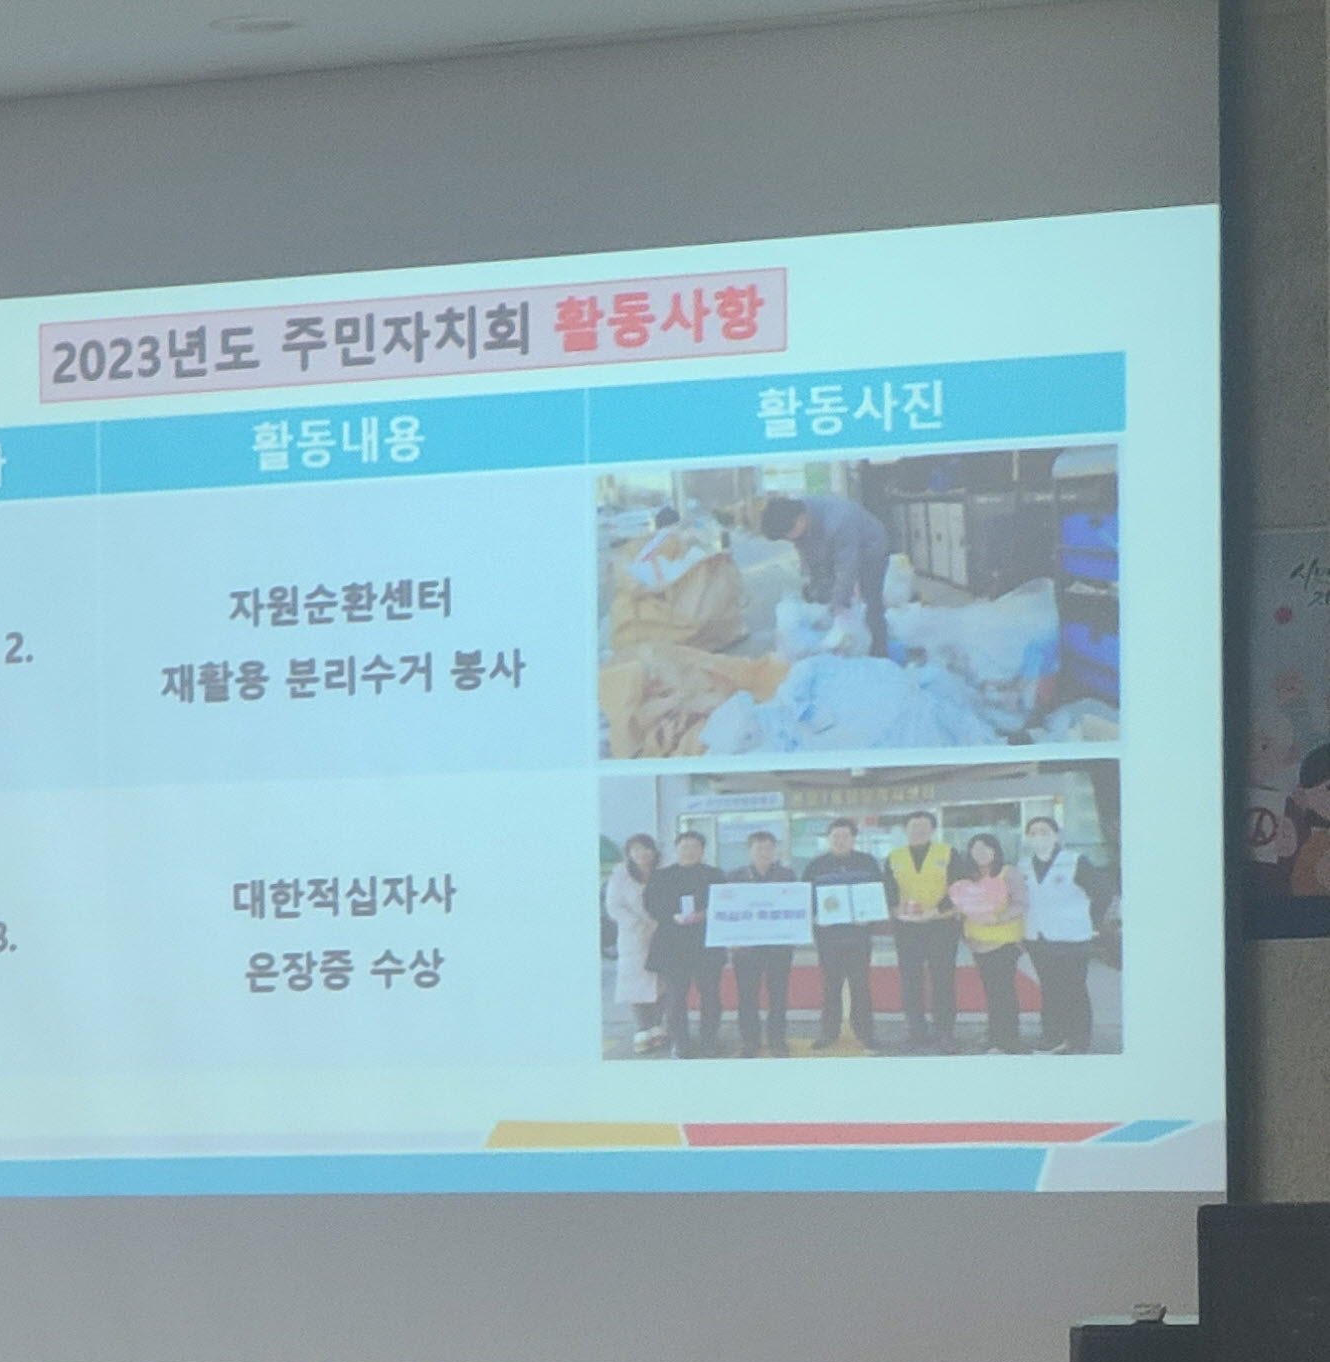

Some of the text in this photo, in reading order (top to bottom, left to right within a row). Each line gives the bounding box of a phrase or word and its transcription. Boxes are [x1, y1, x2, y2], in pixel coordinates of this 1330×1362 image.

[51, 283, 766, 386] 2023년도 주민자치회 활동사항
[756, 379, 946, 439] 활동사진
[251, 414, 426, 473] 활동내용
[228, 577, 453, 629] 자원순환센터
[4, 631, 35, 665] 2.
[160, 647, 528, 705] 재활용 분리수거 봉사
[232, 873, 459, 921] 대한적십자사
[244, 946, 446, 995] 은장증 수상
